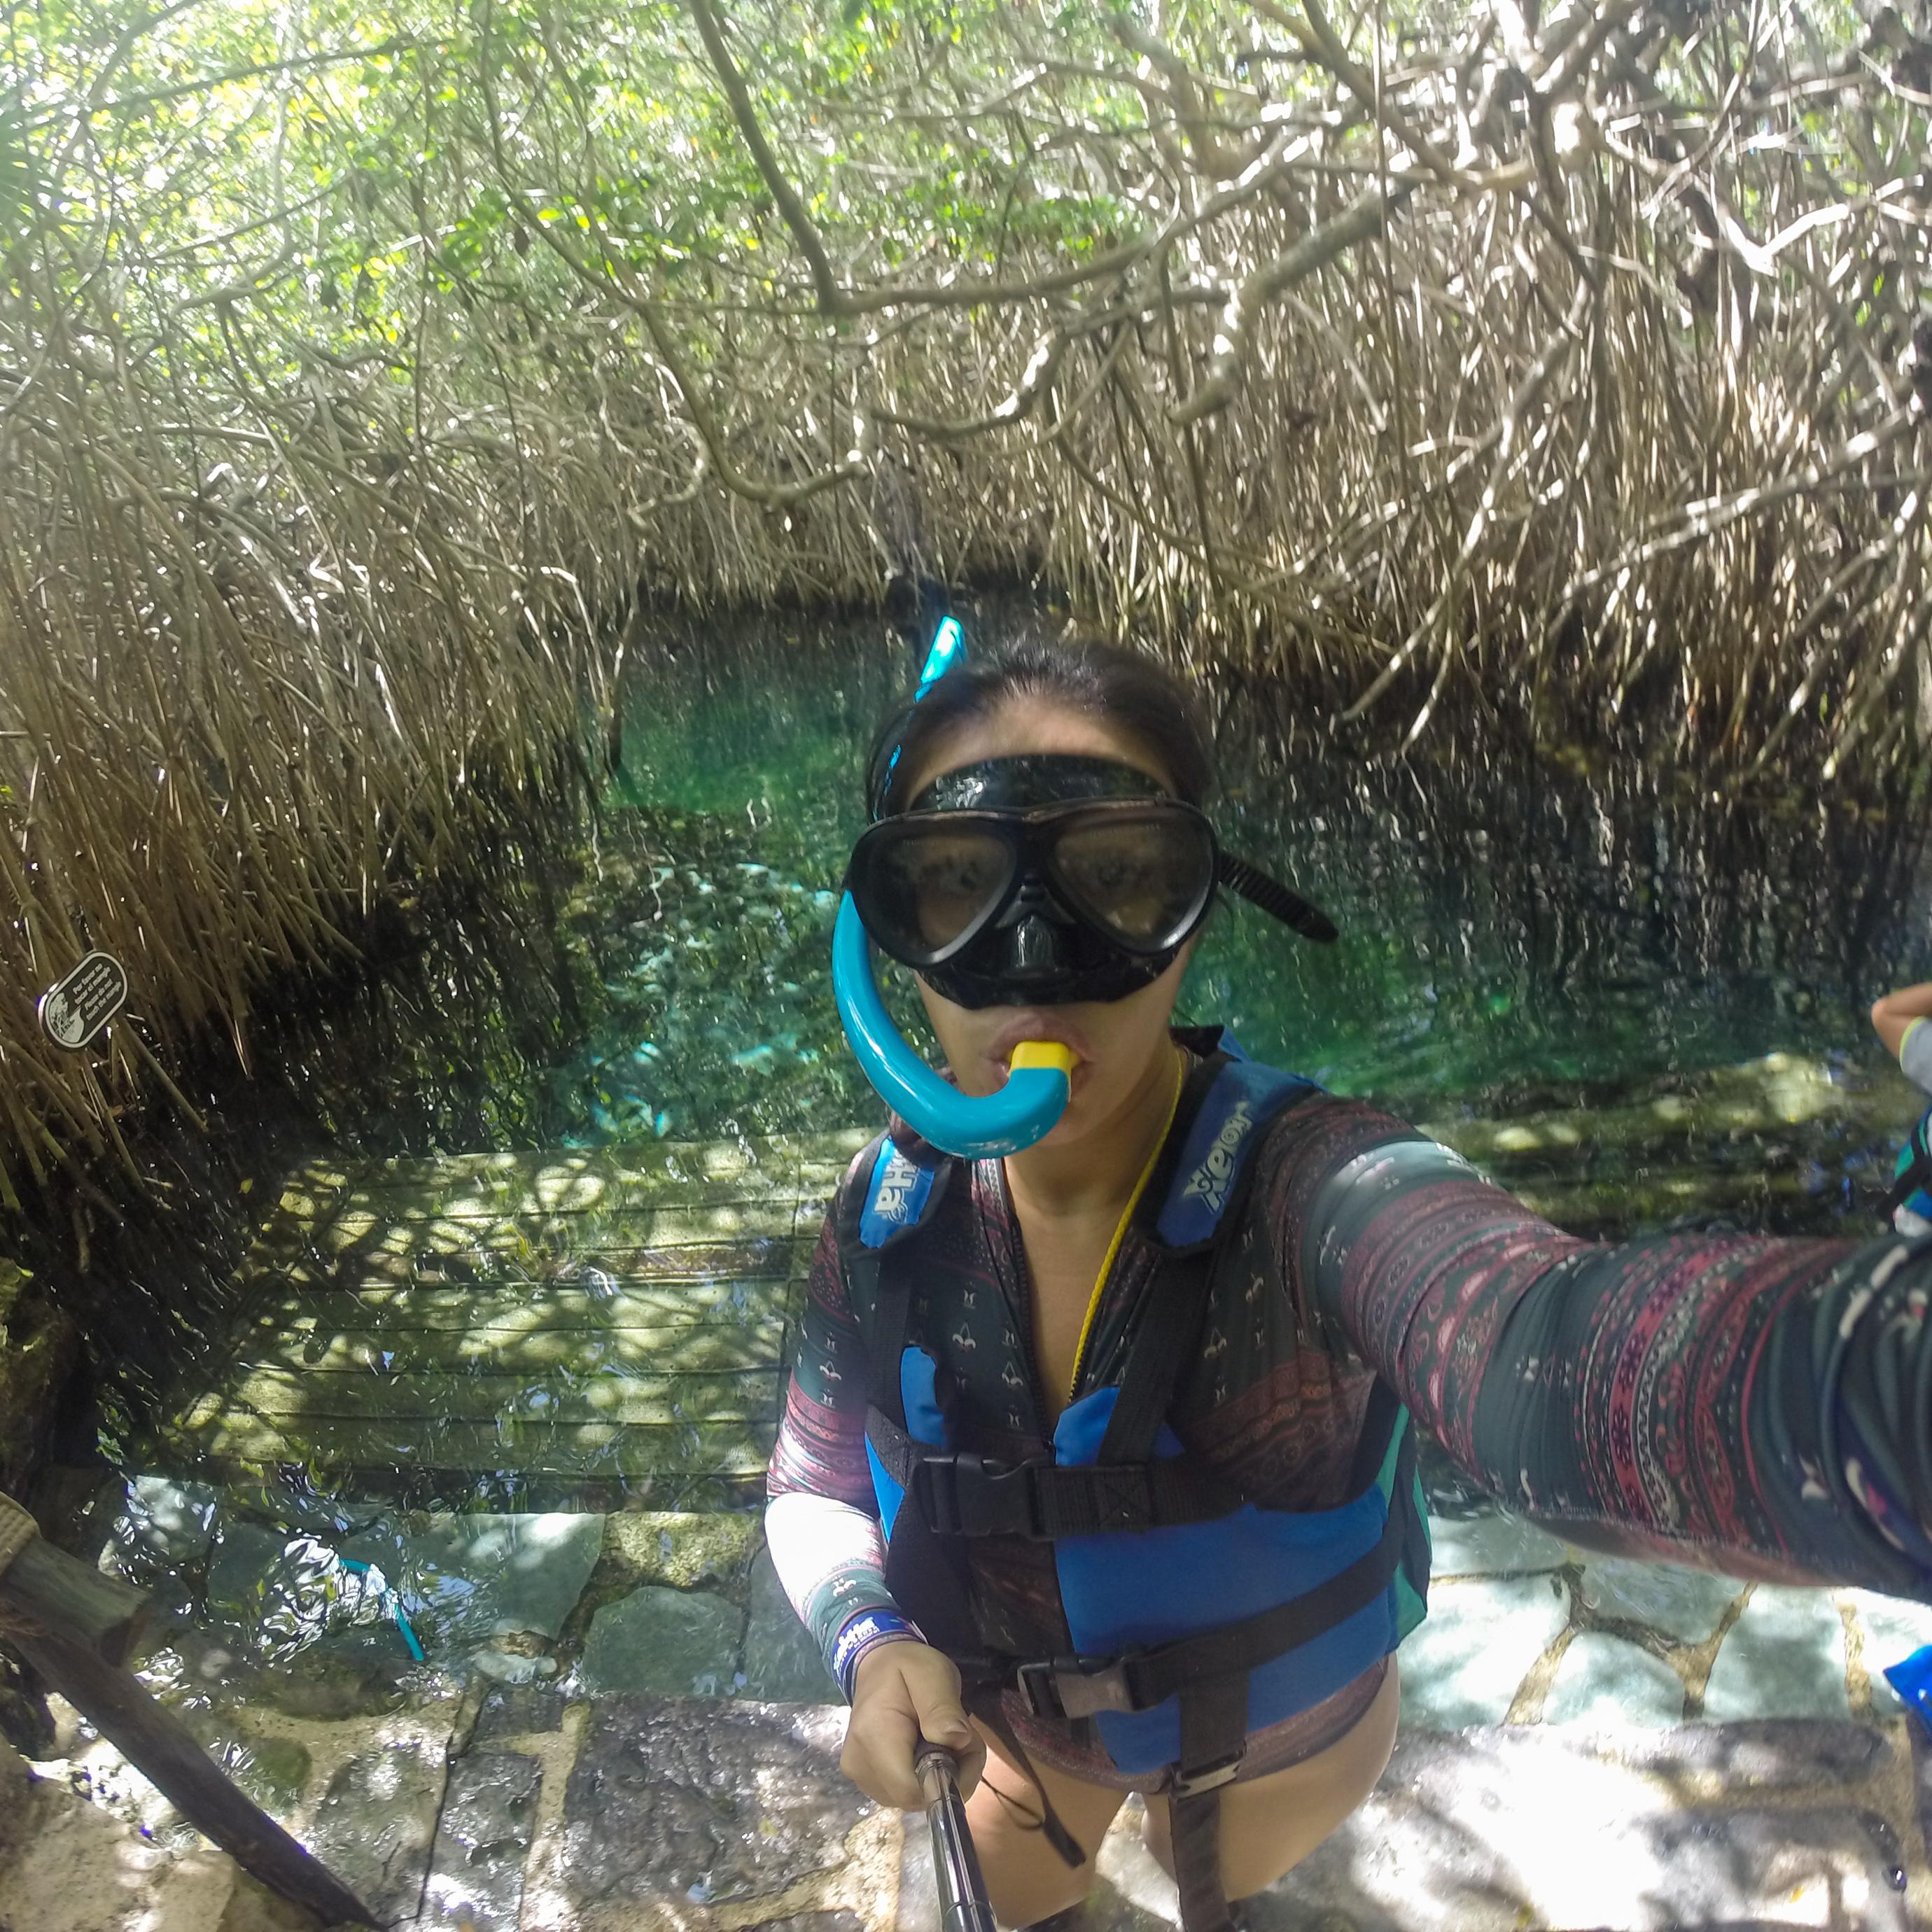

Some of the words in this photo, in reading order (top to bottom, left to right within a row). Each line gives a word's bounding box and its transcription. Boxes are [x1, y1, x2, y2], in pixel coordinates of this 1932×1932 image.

[73, 984, 83, 995] Por
[81, 969, 96, 985] favor
[95, 963, 103, 972] no
[74, 990, 88, 1004] tocar
[92, 967, 111, 986] mangle
[84, 994, 99, 1010] Please
[98, 987, 105, 995] do
[104, 979, 113, 989] not
[86, 1005, 99, 1021] touch
[98, 997, 106, 1007] the
